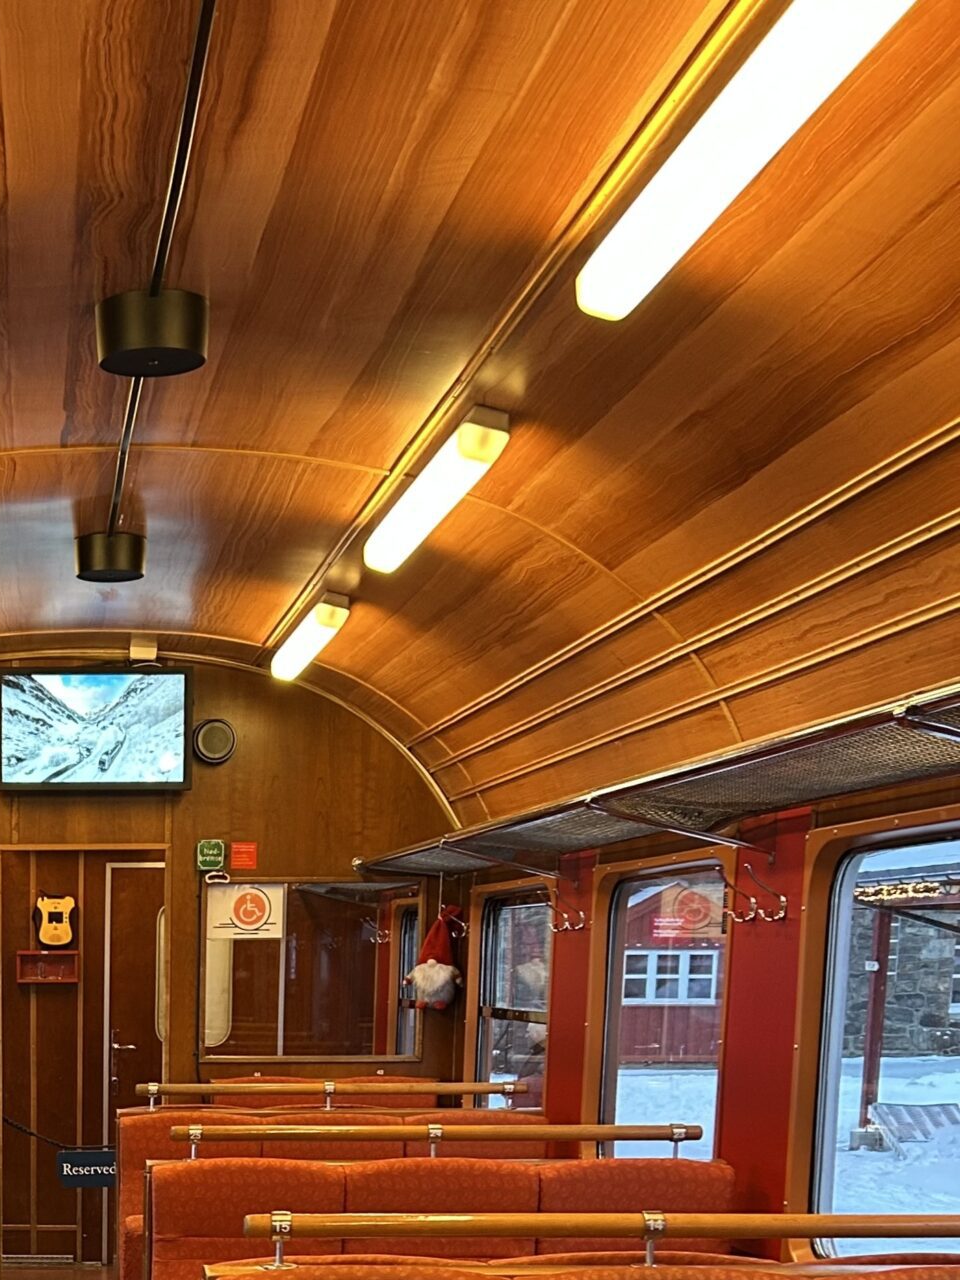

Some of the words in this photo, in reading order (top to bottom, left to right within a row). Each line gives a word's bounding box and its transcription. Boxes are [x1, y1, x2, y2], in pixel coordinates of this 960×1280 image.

[62, 1162, 116, 1176] Reserved
[274, 1222, 291, 1232] 15
[648, 1220, 665, 1231] 14
